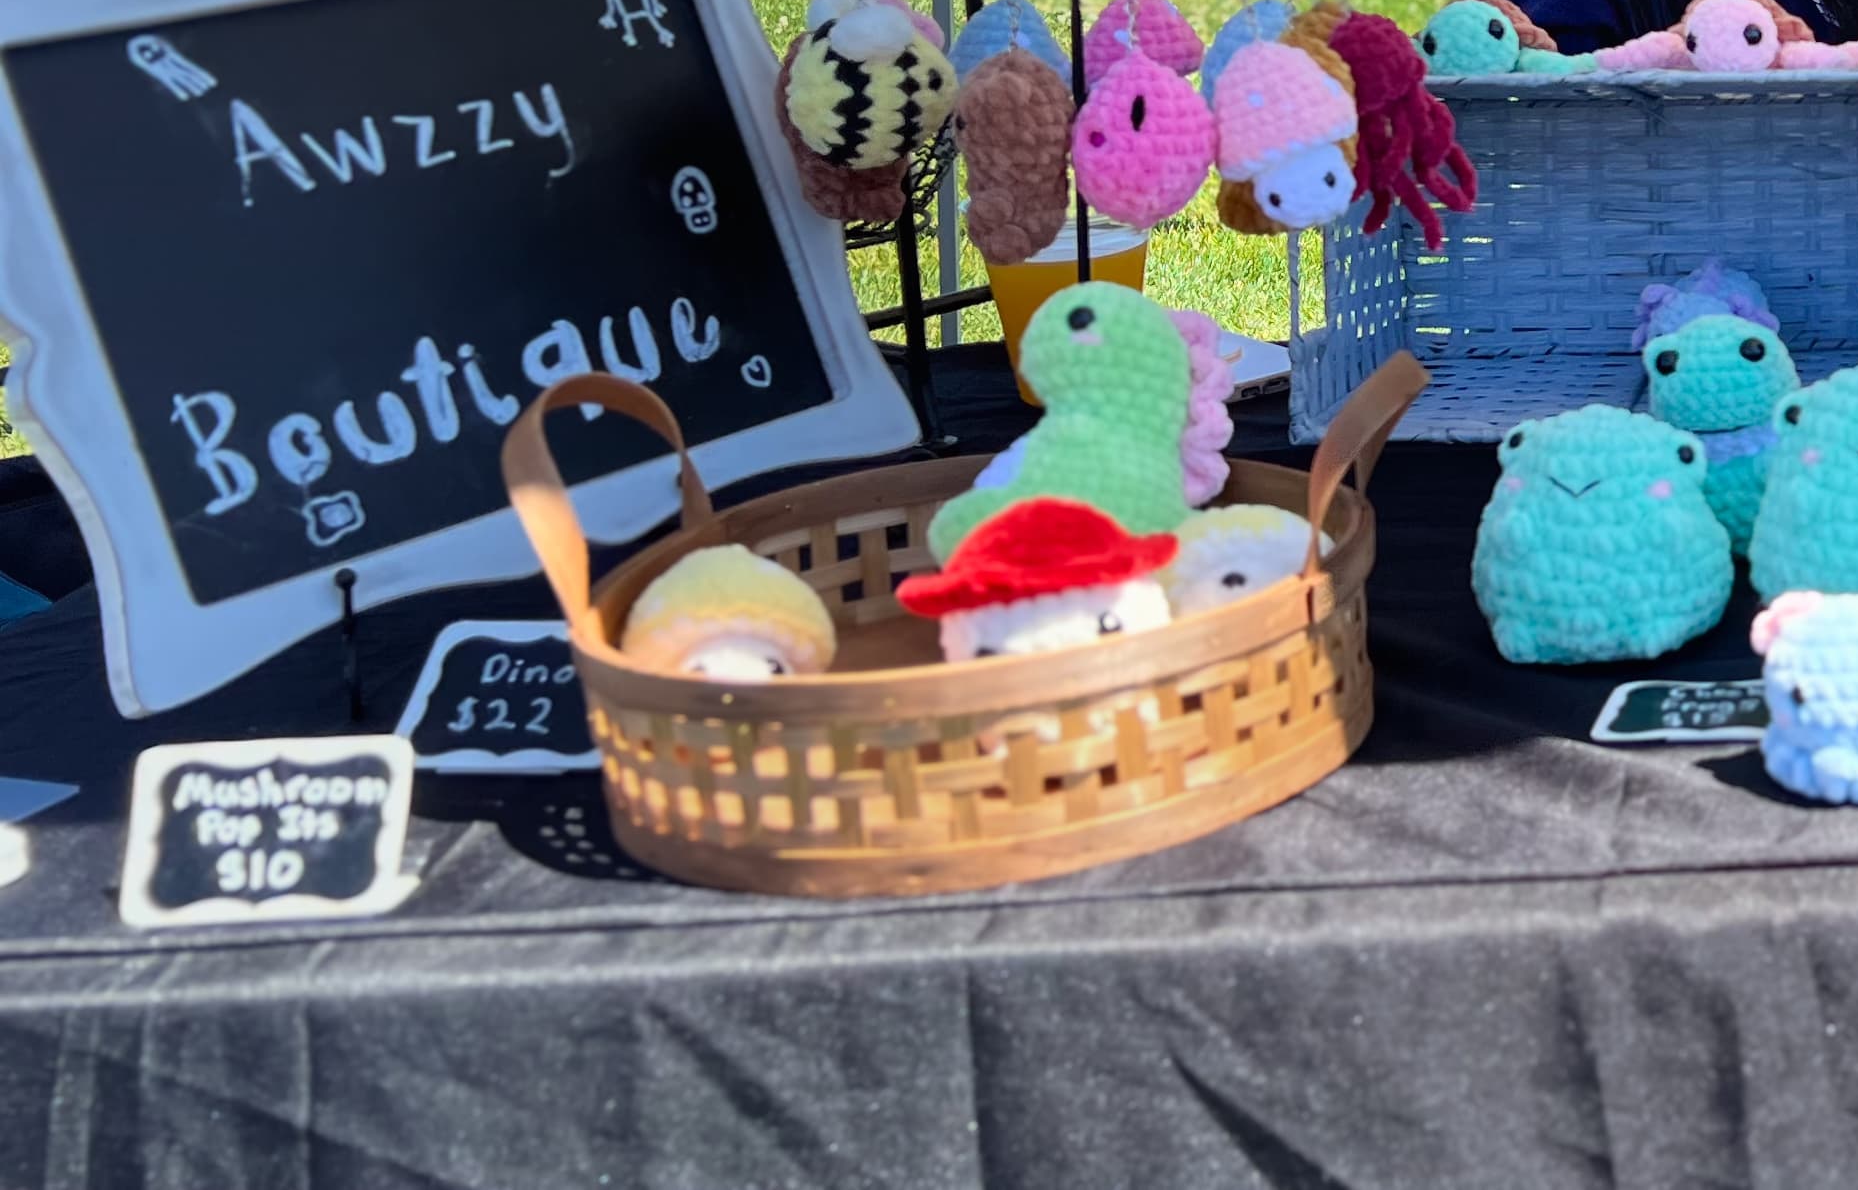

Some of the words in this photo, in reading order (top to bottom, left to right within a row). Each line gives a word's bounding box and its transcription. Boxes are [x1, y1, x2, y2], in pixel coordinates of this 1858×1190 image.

[228, 83, 577, 208] Awzzy
[171, 296, 722, 517] Boutique
[480, 653, 577, 685] Dino
[447, 697, 552, 733] $22
[172, 768, 389, 812] Mushroom
[196, 808, 262, 847] Pop
[216, 849, 305, 892] $10
